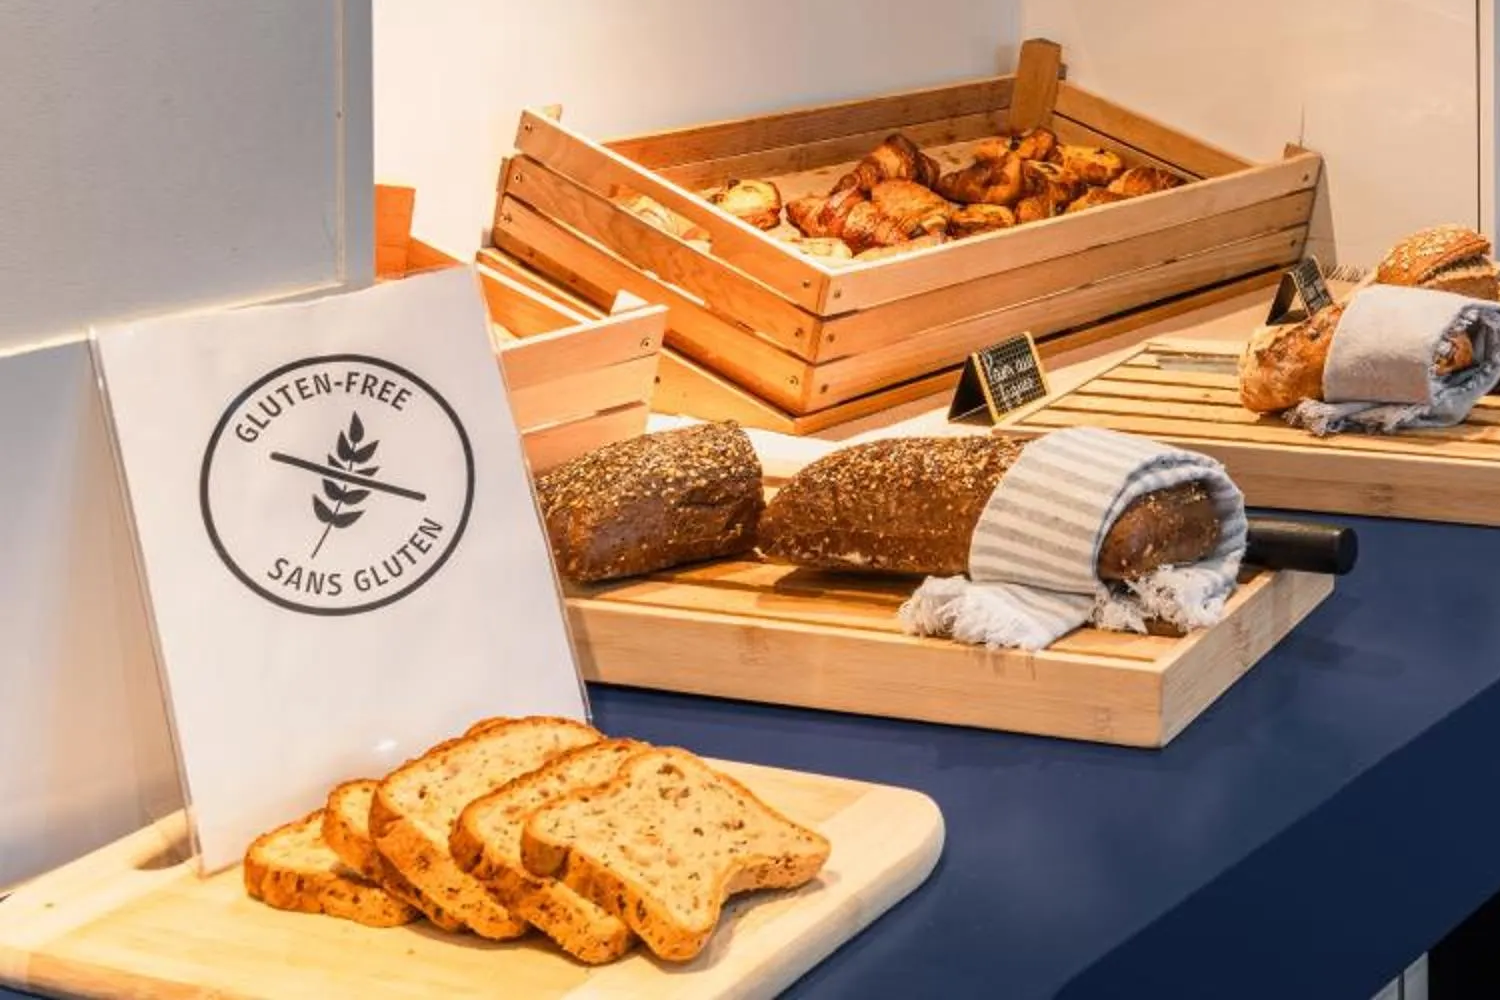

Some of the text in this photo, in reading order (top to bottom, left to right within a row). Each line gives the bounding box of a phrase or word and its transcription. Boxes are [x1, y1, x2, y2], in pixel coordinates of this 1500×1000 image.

[234, 371, 413, 444] GLUTEN-FREE
[266, 516, 445, 597] SANS GLUTEN
